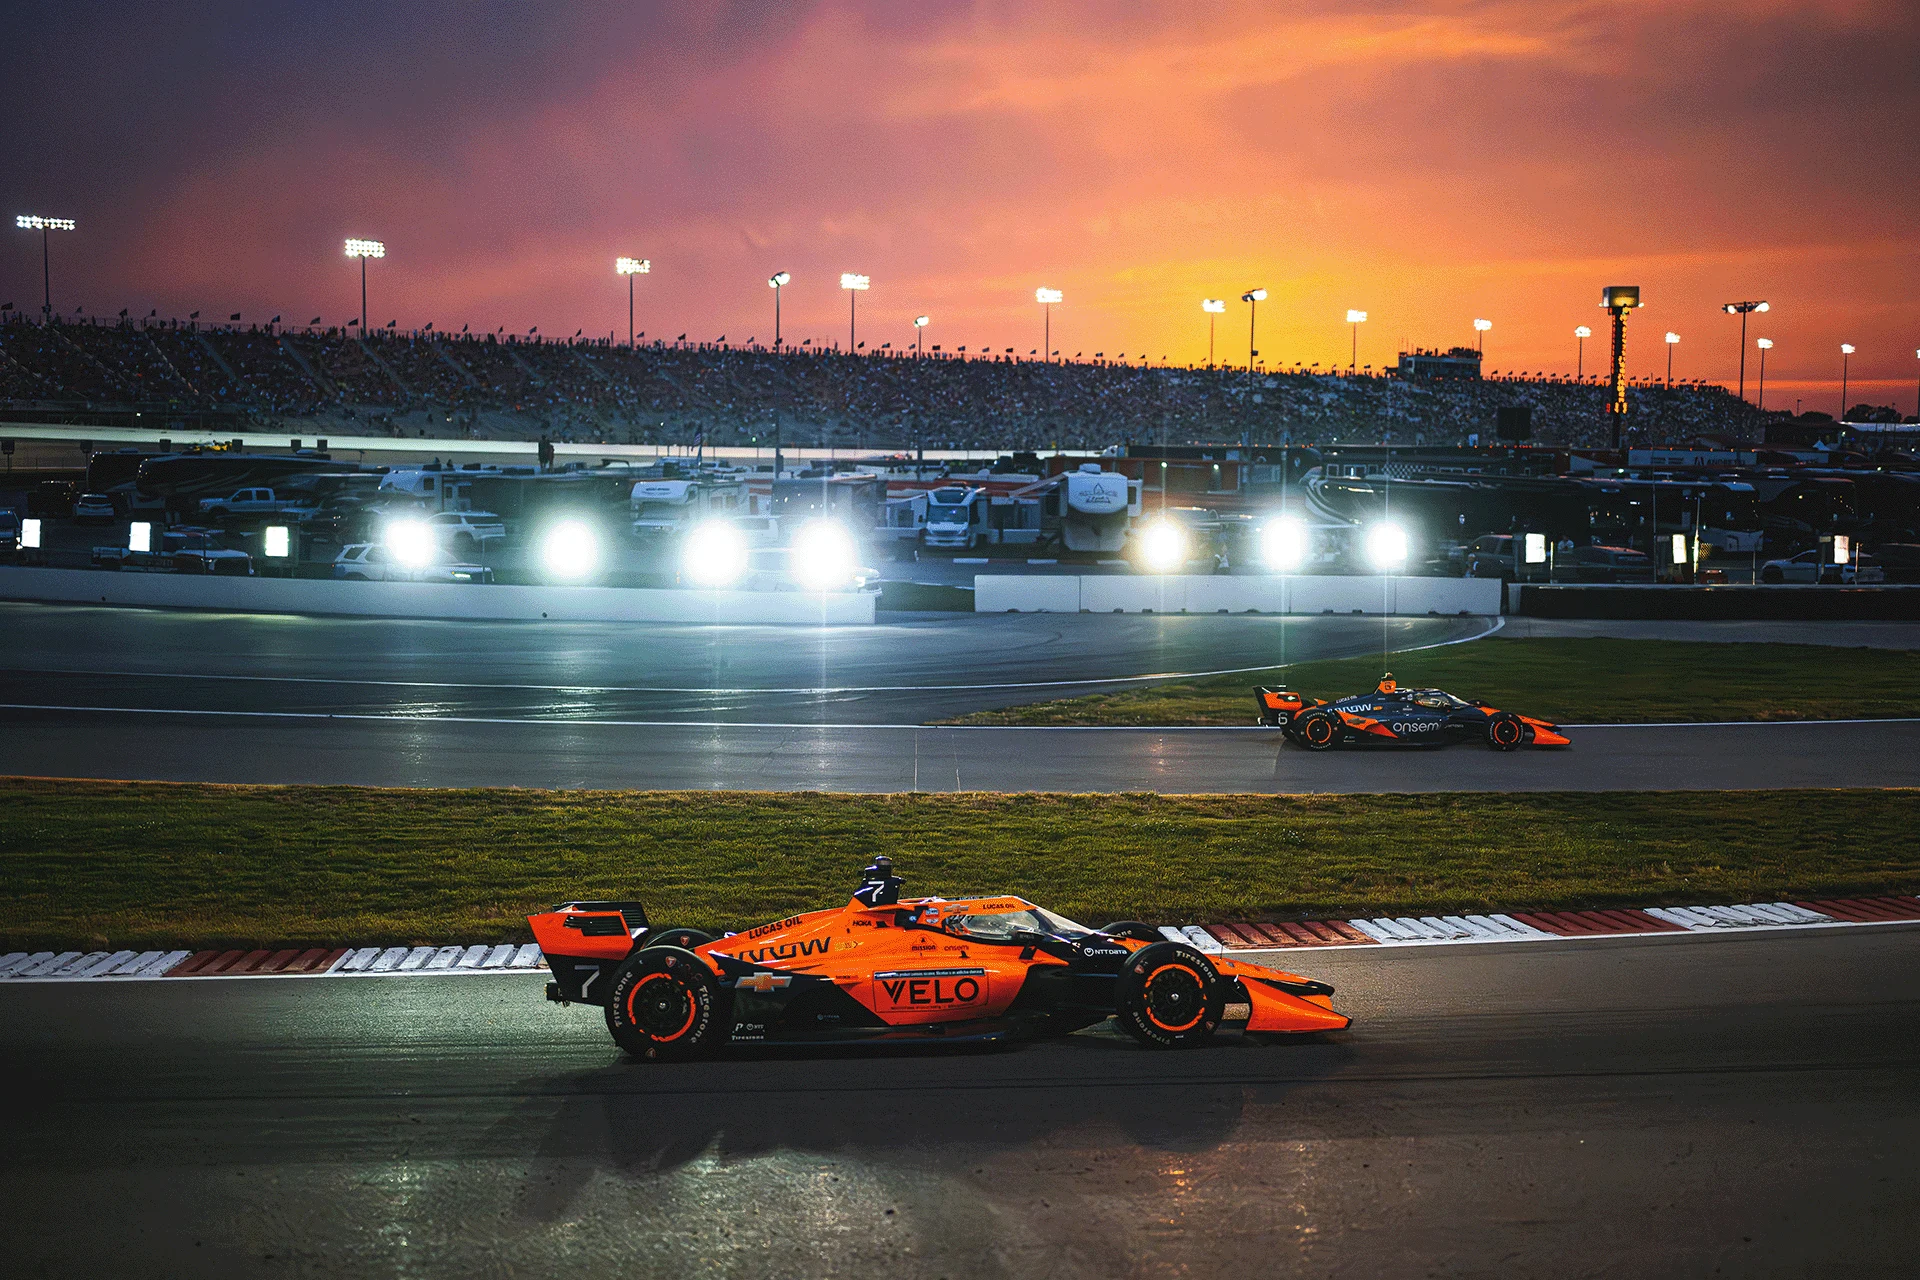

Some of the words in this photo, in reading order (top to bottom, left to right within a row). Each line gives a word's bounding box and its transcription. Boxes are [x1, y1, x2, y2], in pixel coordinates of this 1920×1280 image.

[1278, 712, 1288, 725] 6
[868, 881, 884, 902] 7
[749, 922, 783, 939] LUCAS
[785, 916, 802, 928] OIL
[574, 965, 599, 998] 7
[1175, 950, 1216, 984] Firestone
[613, 971, 633, 1028] Firestone
[882, 977, 980, 1005] VELO
[691, 985, 710, 1043] Firestone
